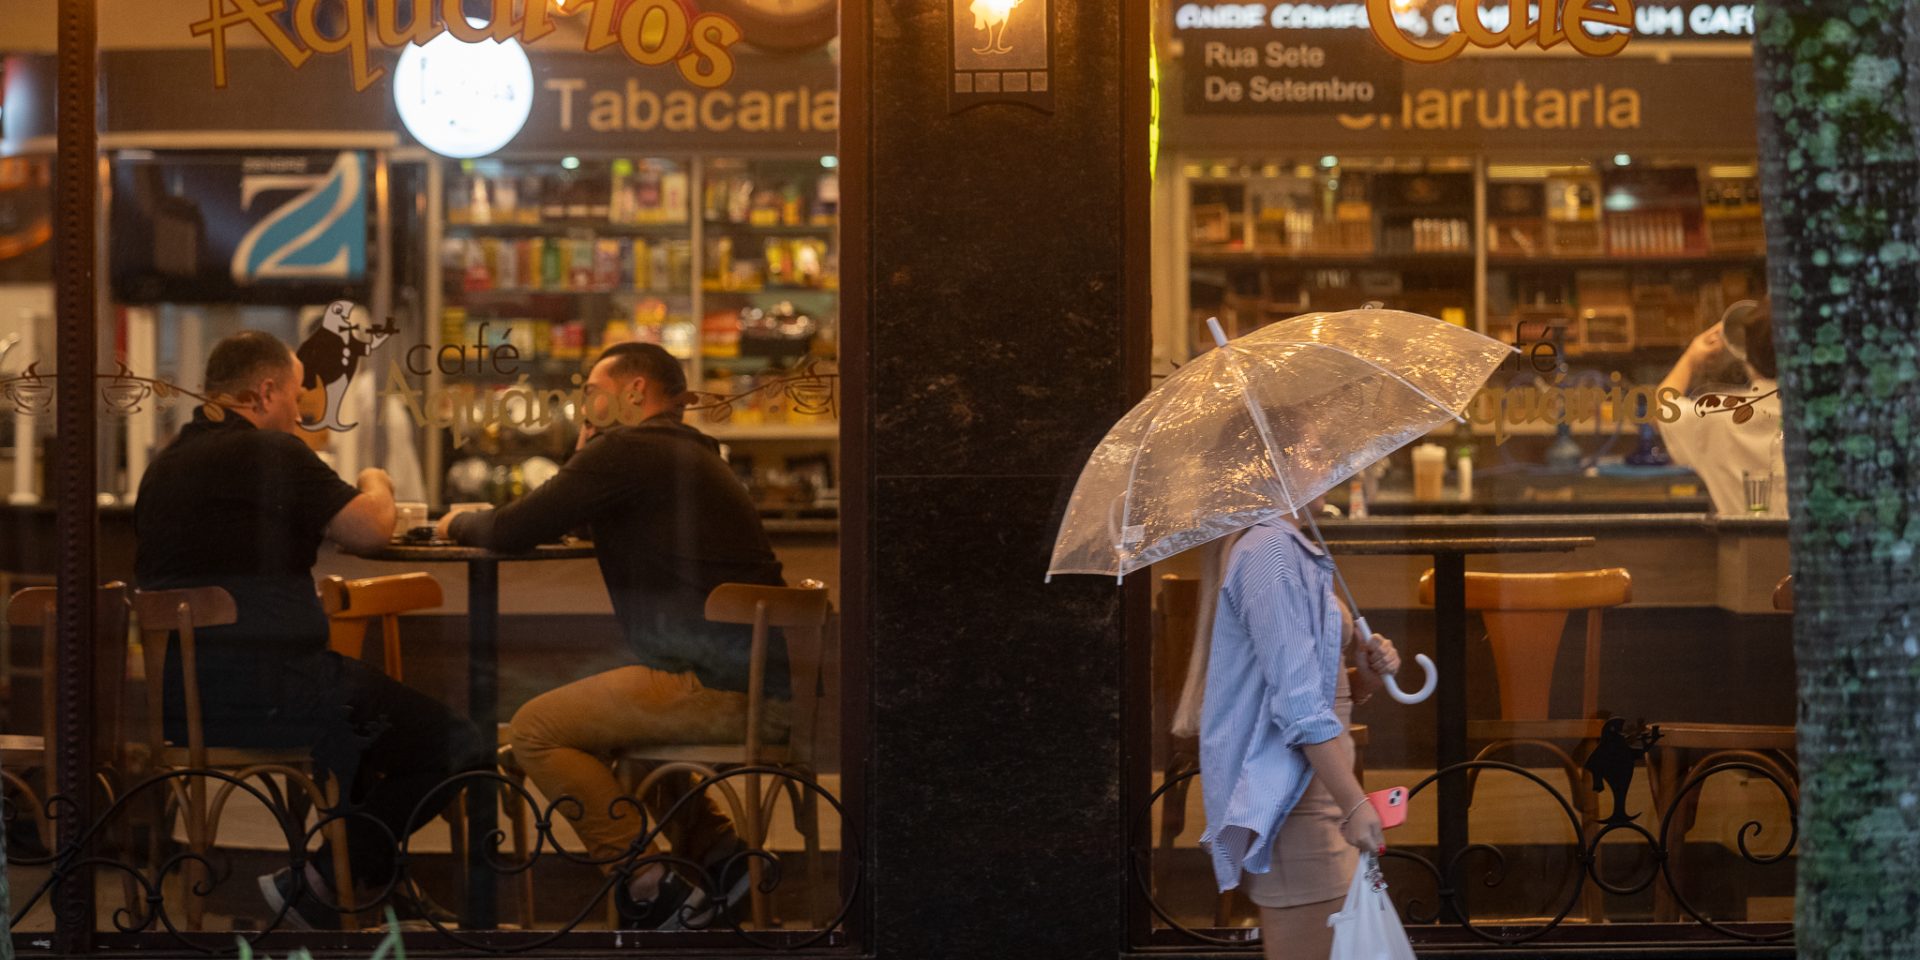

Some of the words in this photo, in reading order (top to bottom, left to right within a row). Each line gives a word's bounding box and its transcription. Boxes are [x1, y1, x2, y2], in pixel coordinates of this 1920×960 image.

[1634, 5, 1684, 35] UM
[1204, 41, 1258, 68] Rua
[1265, 41, 1325, 68] Sete
[544, 78, 839, 132] Tabacaria
[1204, 76, 1243, 101] De
[1249, 76, 1375, 101] Setembro
[1336, 80, 1641, 130] arutaria
[405, 321, 519, 376] café
[1467, 370, 1681, 447] quários
